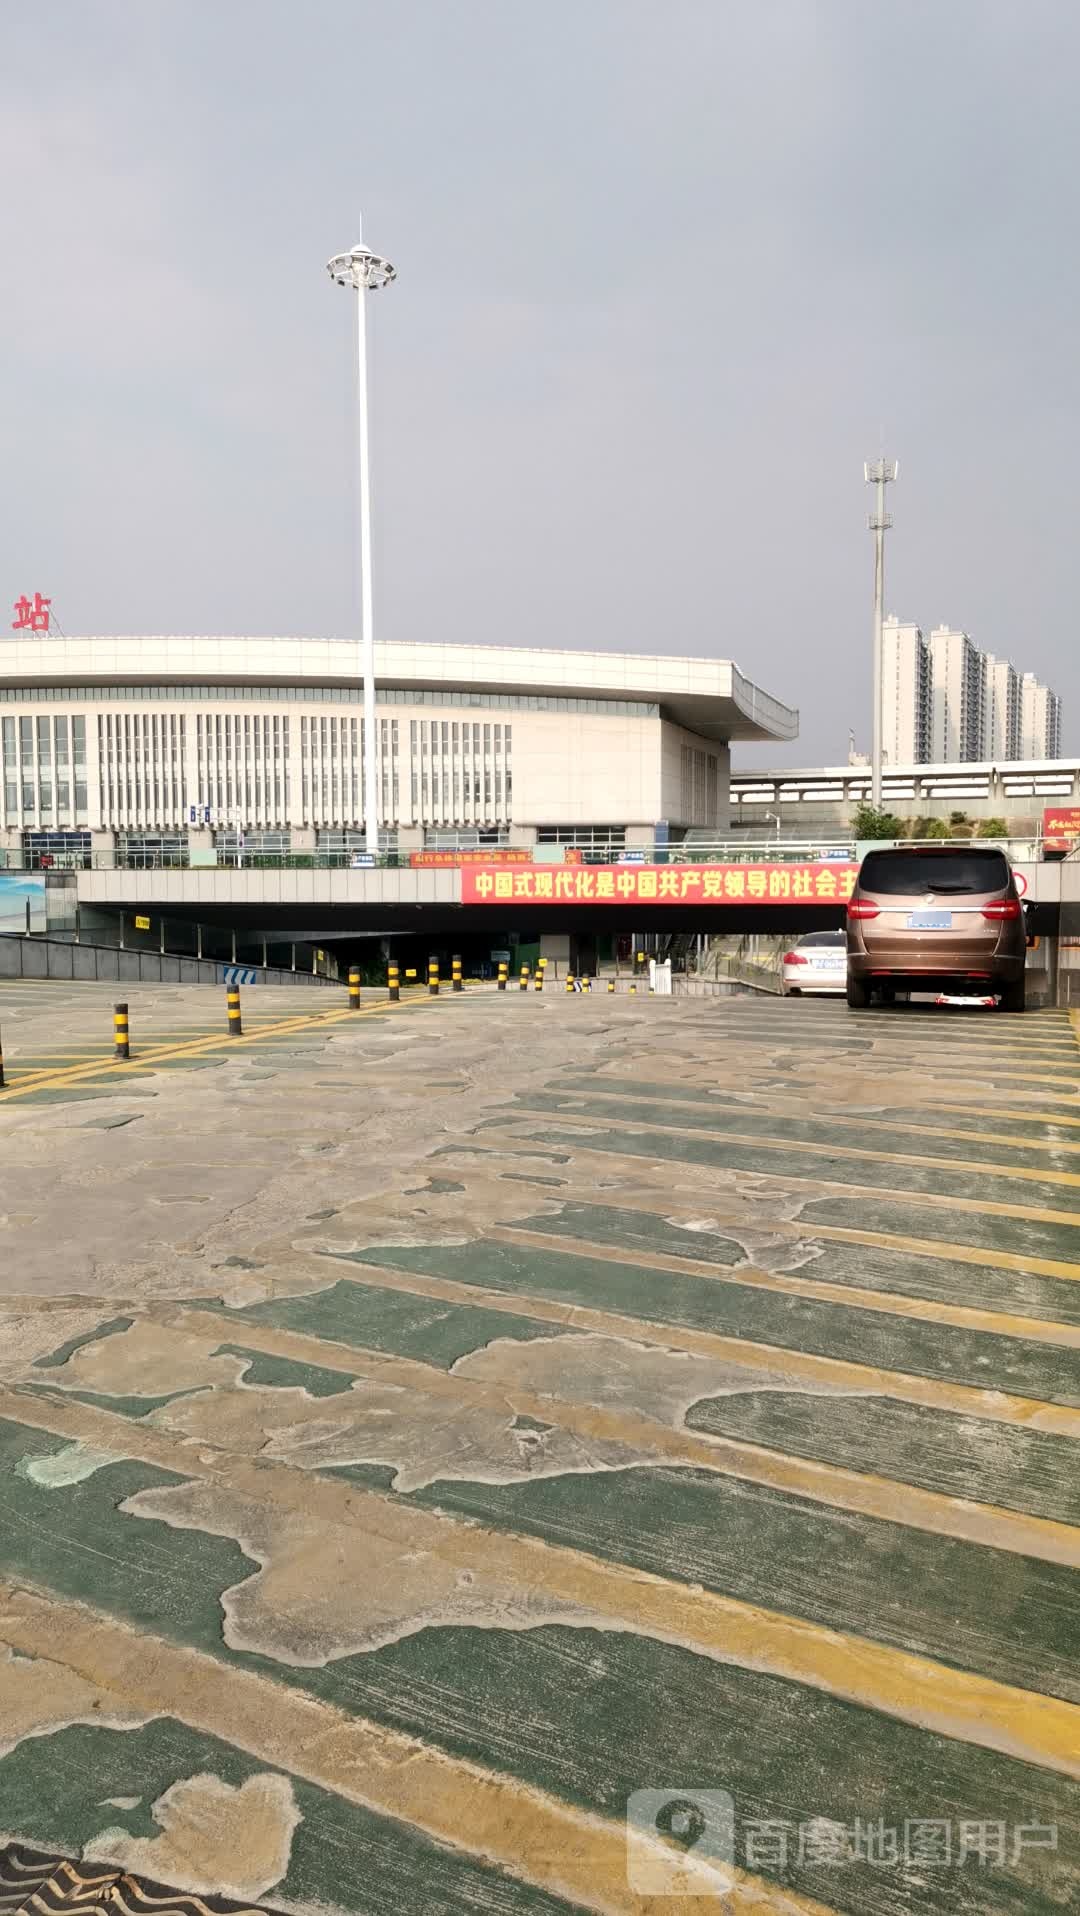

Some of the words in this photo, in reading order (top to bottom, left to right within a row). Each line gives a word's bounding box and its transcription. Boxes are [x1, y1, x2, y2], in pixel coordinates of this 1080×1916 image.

[13, 592, 51, 631] 站
[475, 870, 857, 897] 中国式现代化是中国共产党领导的社会主
